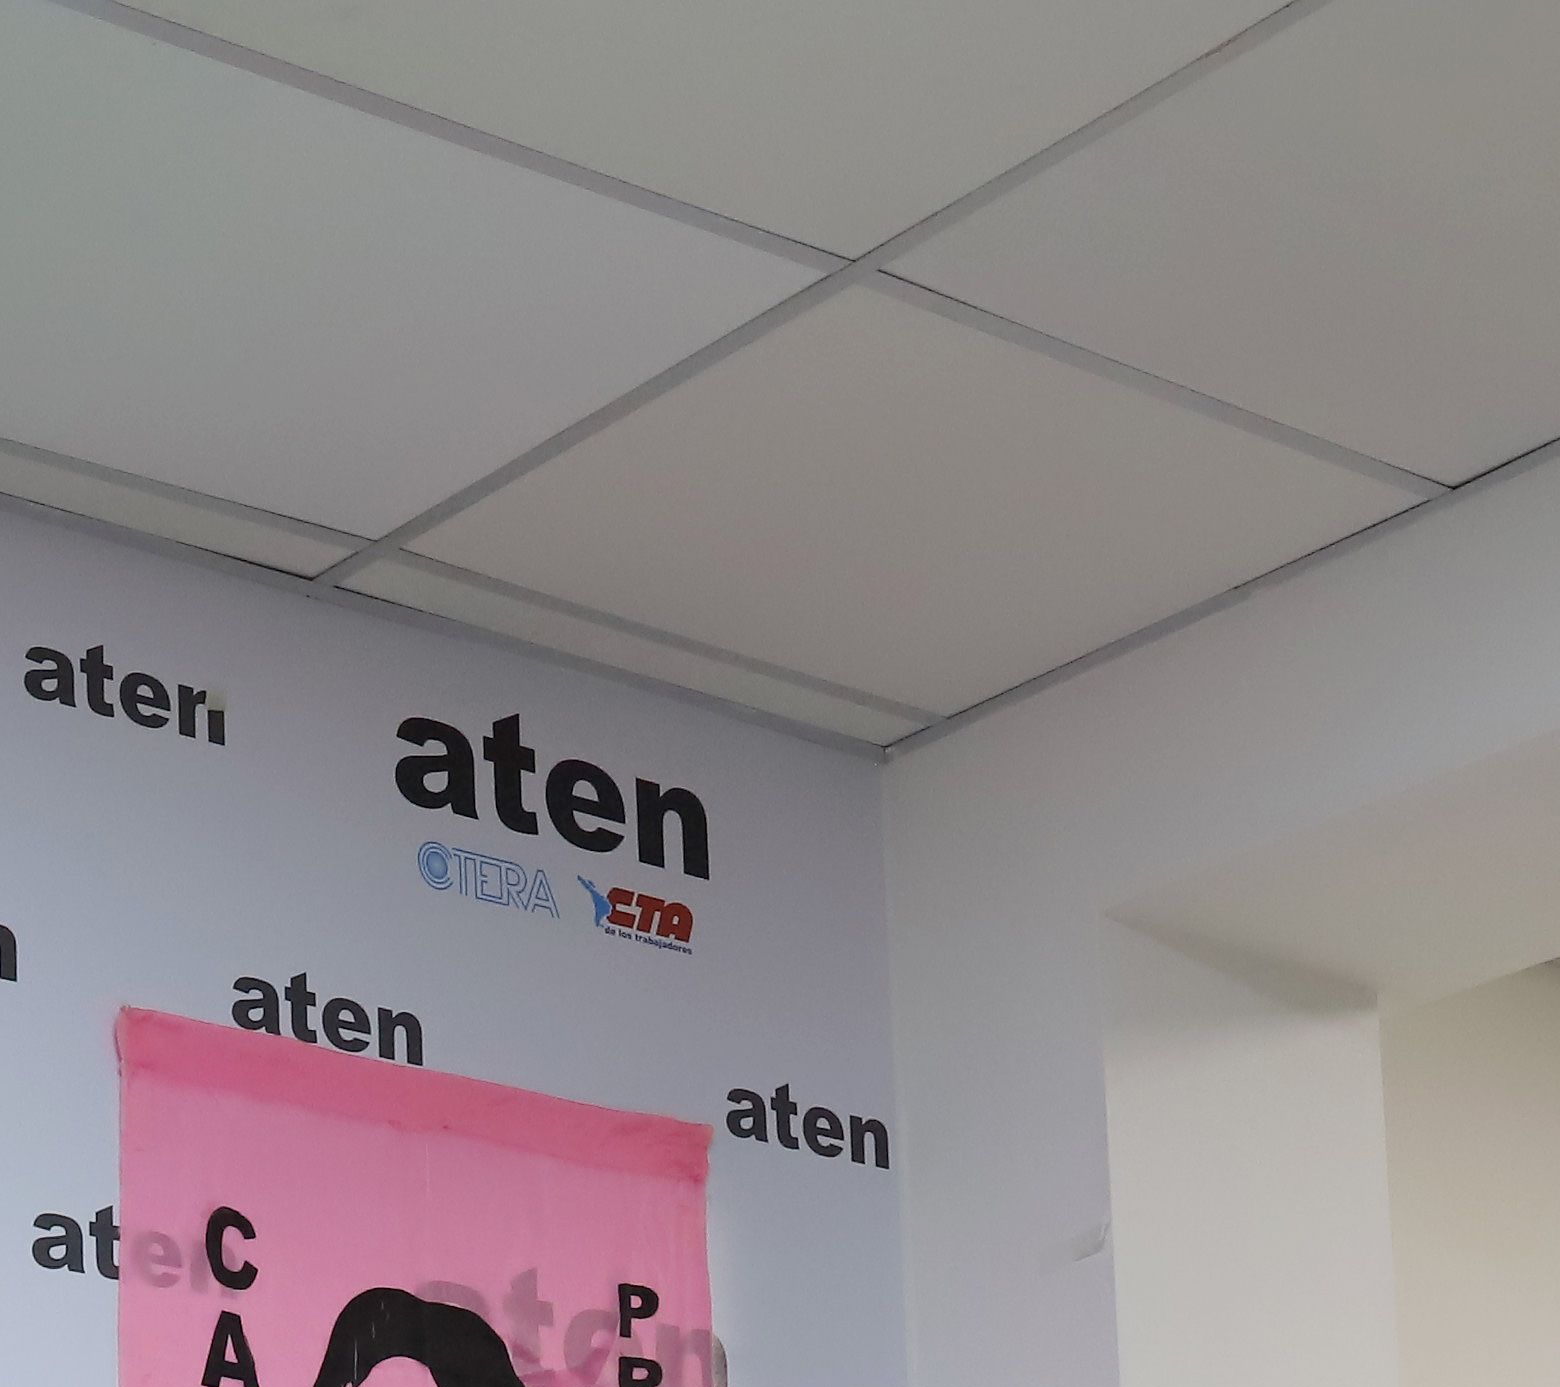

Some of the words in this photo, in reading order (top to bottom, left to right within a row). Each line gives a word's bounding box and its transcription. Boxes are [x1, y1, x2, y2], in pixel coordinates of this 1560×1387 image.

[394, 713, 710, 881] aten
[606, 887, 693, 943] CTA
[231, 972, 424, 1066] aten
[727, 1083, 891, 1170] aten
